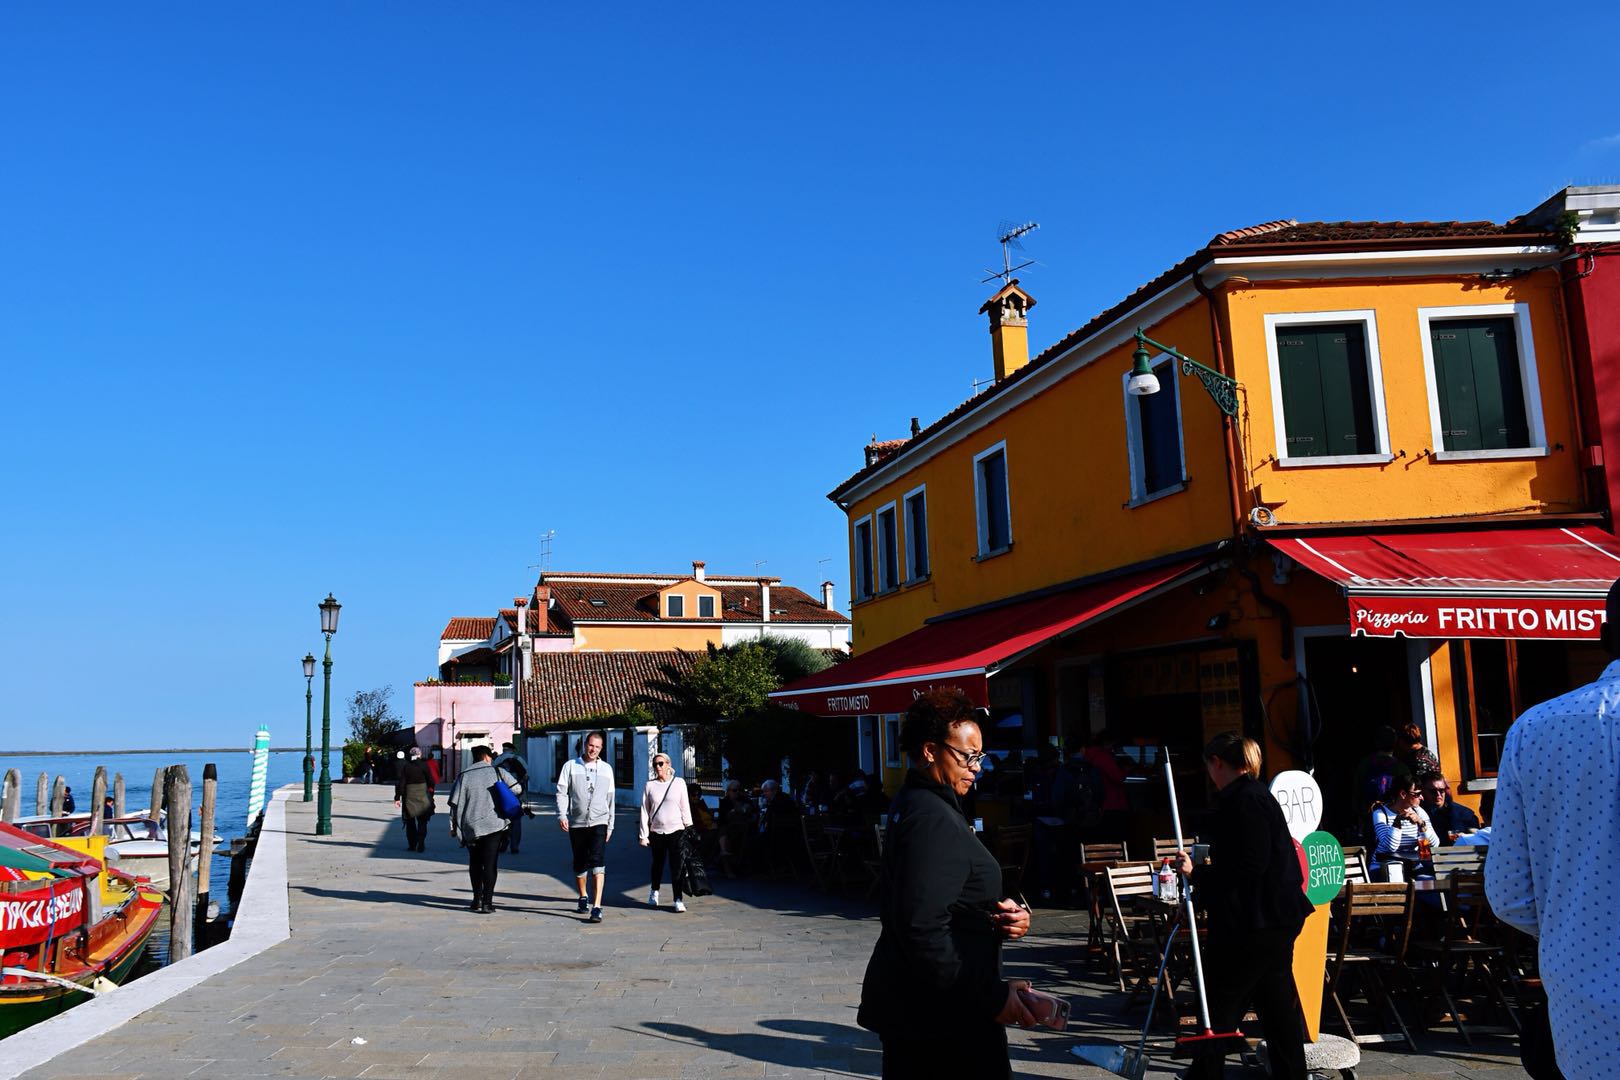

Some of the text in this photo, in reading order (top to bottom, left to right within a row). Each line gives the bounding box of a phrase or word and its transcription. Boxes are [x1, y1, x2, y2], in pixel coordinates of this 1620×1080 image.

[1438, 608, 1539, 630] FRITTO
[1545, 609, 1607, 631] MIST
[827, 694, 870, 711] FRITTO MISTO
[1277, 786, 1316, 824] BAR
